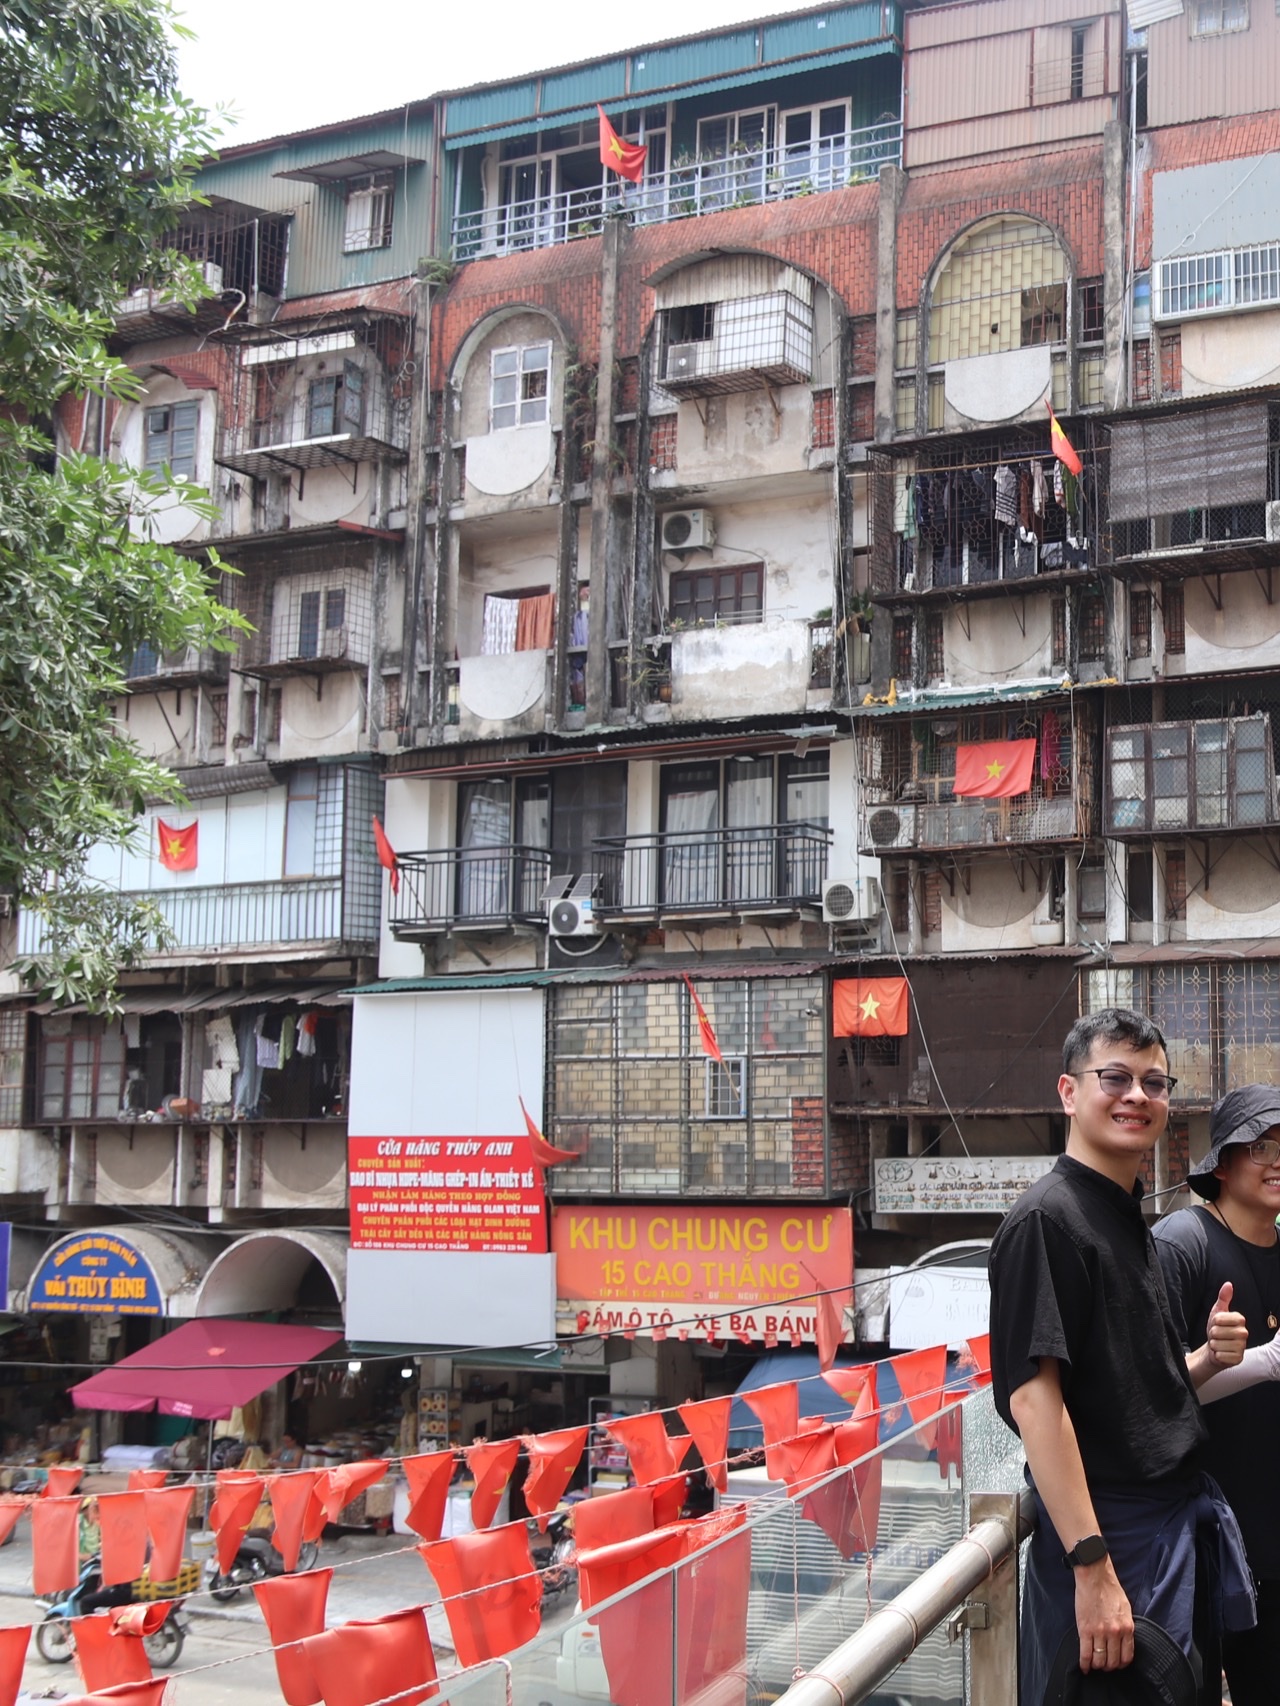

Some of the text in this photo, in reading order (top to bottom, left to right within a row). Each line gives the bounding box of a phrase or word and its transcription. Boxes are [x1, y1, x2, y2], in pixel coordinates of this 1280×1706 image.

[484, 1142, 514, 1156] ANH
[570, 1214, 833, 1253] KHU CHUNG CƯ
[601, 1251, 800, 1289] 15 CAO THẮNG
[646, 1308, 674, 1329] TÔ
[730, 1313, 757, 1332] BA
